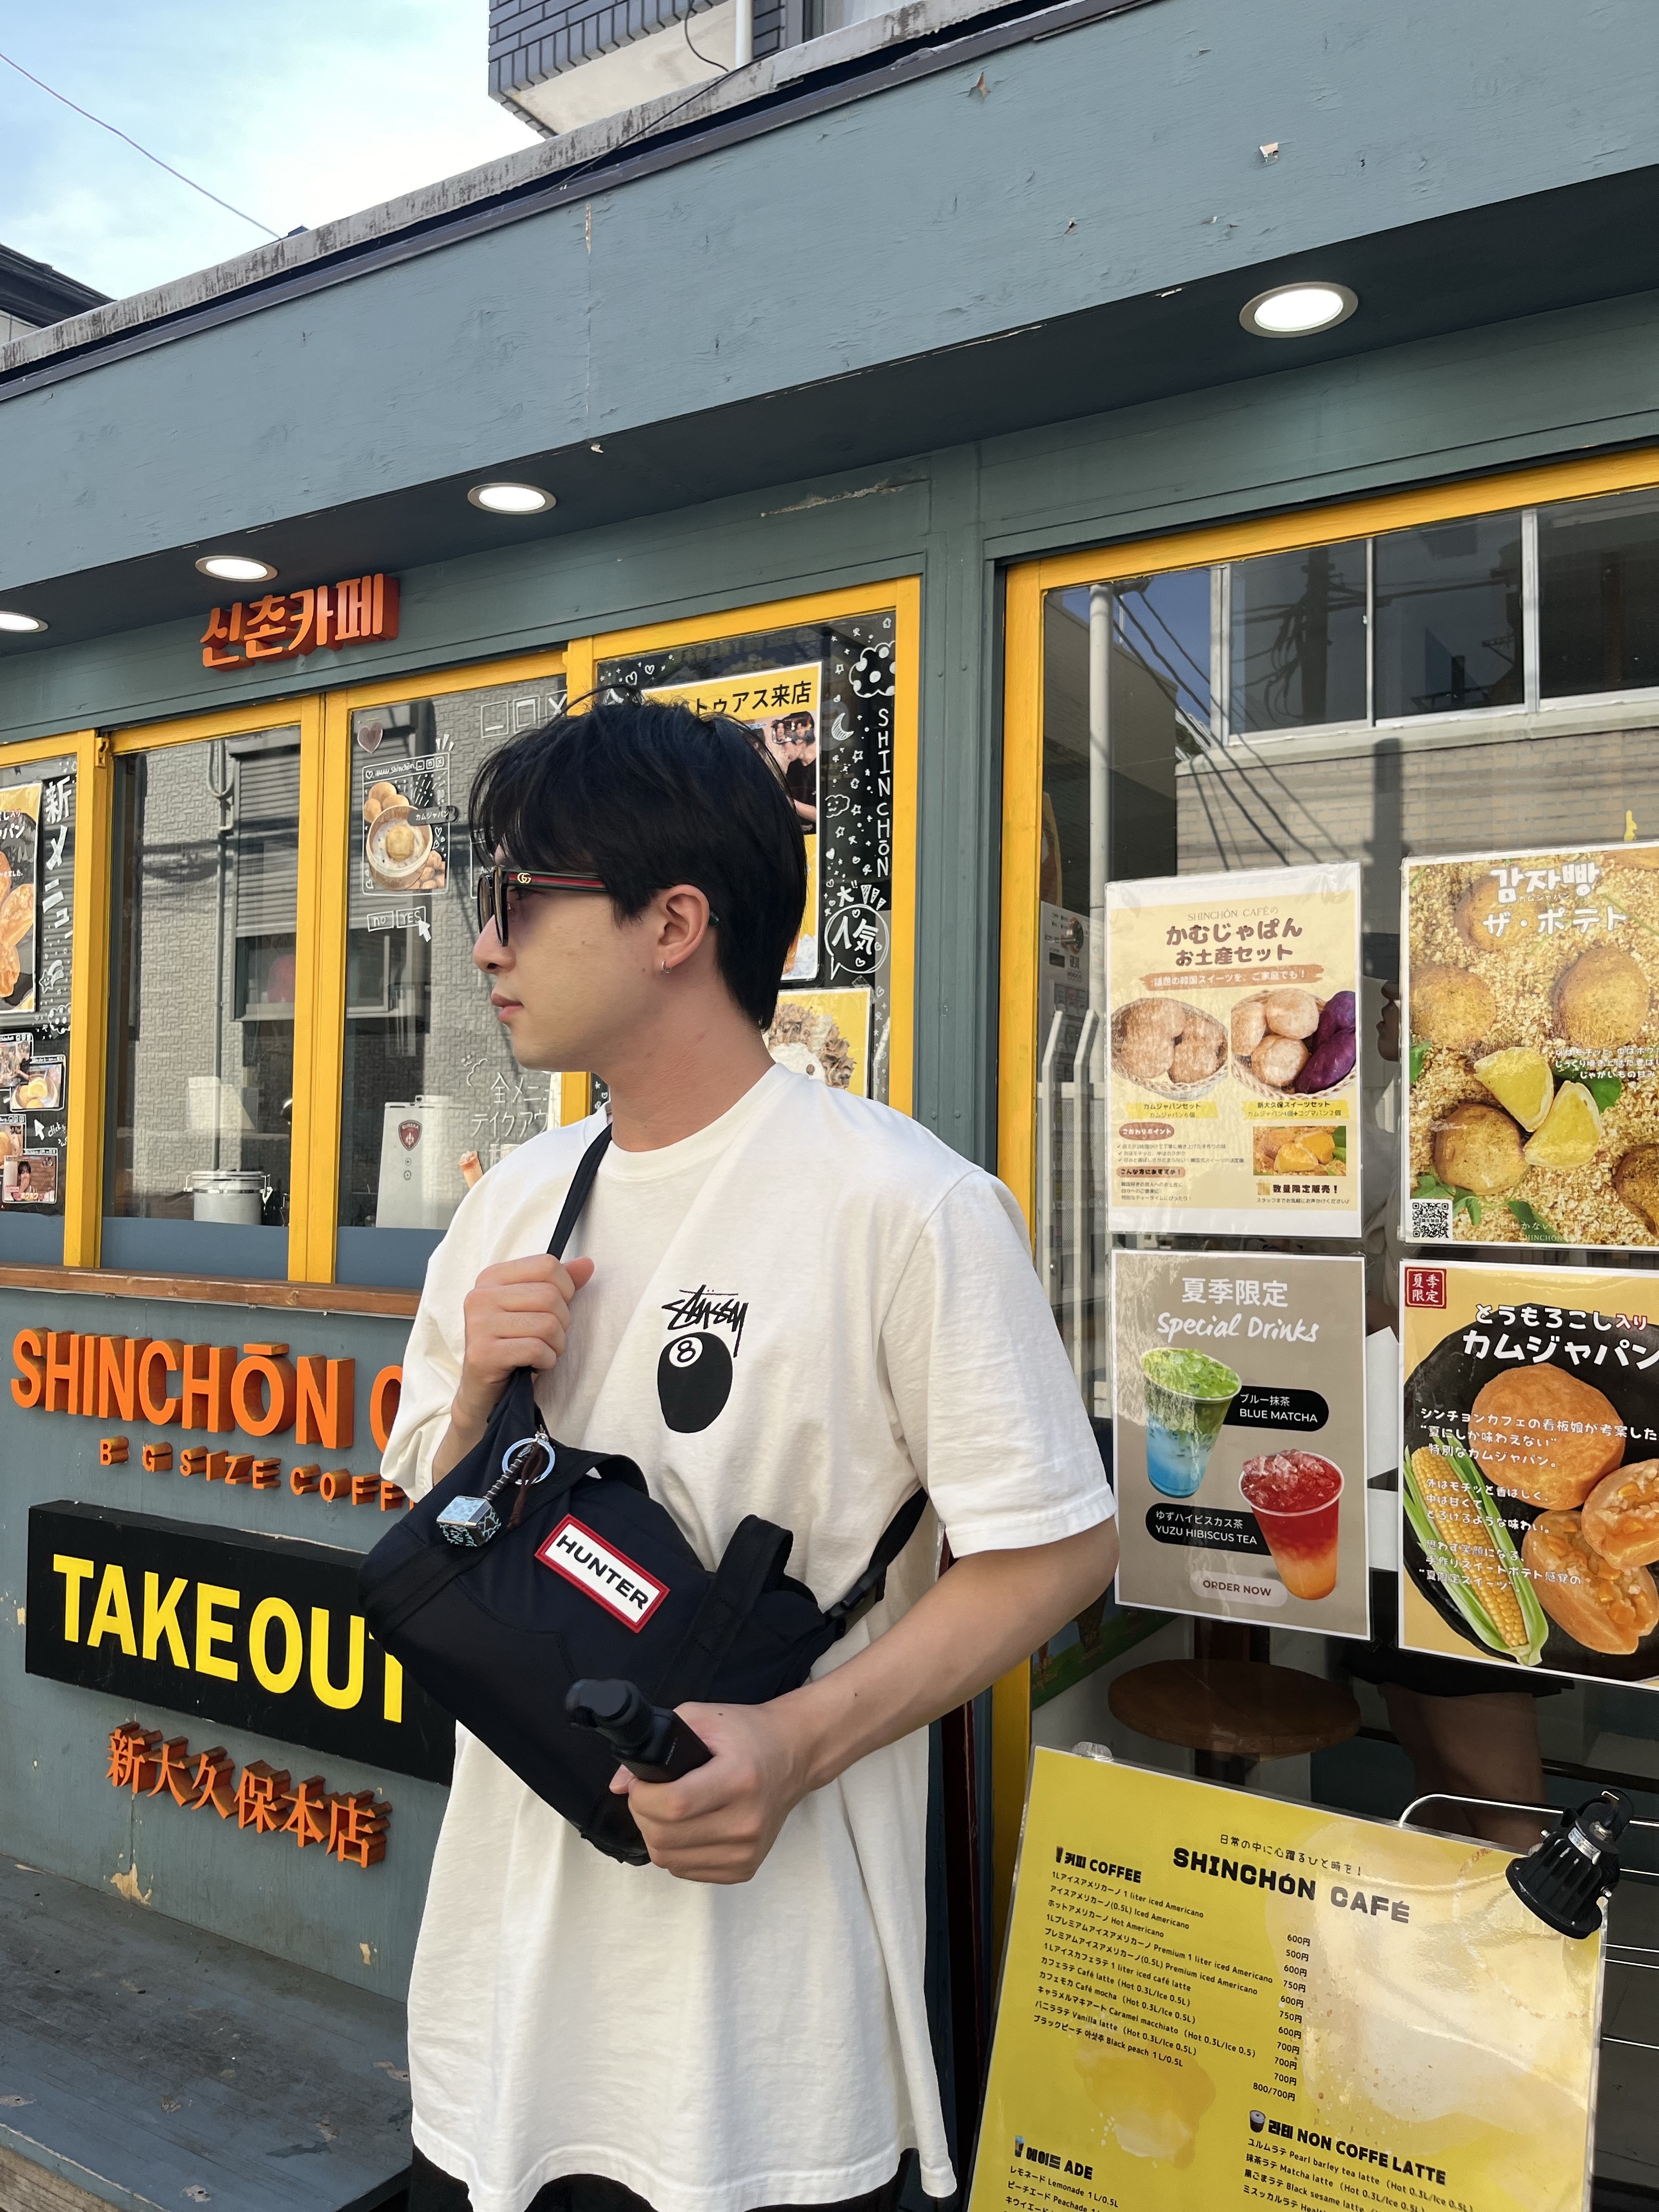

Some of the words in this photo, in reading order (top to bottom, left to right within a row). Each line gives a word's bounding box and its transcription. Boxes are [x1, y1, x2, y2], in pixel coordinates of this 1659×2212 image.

[200, 573, 385, 668] 신촌카페
[1490, 862, 1601, 904] 감자빵
[400, 910, 422, 924] YES
[831, 915, 879, 955] 人気
[1166, 917, 1304, 946] かむじゃぱん
[1482, 905, 1627, 938] ザ・ポテト
[1175, 944, 1294, 967] お土産セット
[1272, 1184, 1339, 1194] 数量限定販売！
[1181, 1277, 1289, 1308] 夏季限定
[1156, 1312, 1243, 1344] Special
[1247, 1316, 1320, 1343] Drinks
[1475, 1304, 1648, 1331] とうもろこし入り
[676, 1339, 696, 1363] 8
[1462, 1329, 1659, 1371] カムジャパン
[10, 1327, 355, 1449] SHINCHŌN
[1240, 1393, 1290, 1407] ブルー抹茶
[1239, 1408, 1268, 1420] BLUE
[1271, 1410, 1318, 1423] MATCHA
[1420, 1408, 1657, 1441] シンチョンカフェの看板娘が考案した
[180, 1445, 281, 1490] SIZE
[290, 1462, 415, 1513] COFF
[1155, 1510, 1244, 1530] ゆずハイビスカス茶
[1426, 1494, 1483, 1509] 中は甘くて
[1155, 1524, 1183, 1536] YUZU
[1186, 1528, 1234, 1543] HIBISCUS
[1237, 1534, 1257, 1546] TEA
[555, 1534, 650, 1611] HUNTER
[1203, 1579, 1240, 1593] ORDER
[1243, 1584, 1272, 1597] NOW
[53, 1553, 403, 1724] TAKEOUT
[106, 1725, 385, 1869] 新大久保本店
[1064, 1852, 1087, 1869] 커피
[1089, 1859, 1142, 1884] COFFEE
[1173, 1847, 1316, 1901] SHINCHÓN
[1330, 1886, 1410, 1924] CAFÉ
[1048, 1899, 1109, 1921] ホットアメリカーノ
[1110, 1916, 1124, 1927] Hot
[1126, 1921, 1164, 1938] Americano
[1284, 1964, 1307, 1978] 600円
[1130, 1892, 1147, 1902] liter
[1148, 1897, 1164, 1908] iced
[1165, 1901, 1204, 1918] Americano
[1287, 1934, 1311, 1947] 600円
[1134, 1908, 1149, 1918] Iced
[1150, 1913, 1189, 1929] Americano
[1286, 1949, 1309, 1962] 500円
[1044, 1942, 1109, 1967] 1Lアイスカフェラテ
[1117, 1963, 1134, 1974] liter
[1136, 1969, 1152, 1980] iced
[1153, 1976, 1170, 1985] café
[1172, 1979, 1191, 1991] latte
[1279, 2010, 1302, 2024] 750円
[1153, 1944, 1186, 1959] Premium
[1194, 1955, 1212, 1966] liter
[1214, 1960, 1230, 1972] iced
[1232, 1966, 1273, 1984] Americano
[1283, 1979, 1306, 1993] 750円
[1165, 1962, 1197, 1978] Premium
[1199, 1972, 1216, 1983] iced
[1217, 1977, 1258, 1995] Americano
[1280, 1995, 1304, 2008] 600円
[1039, 1971, 1074, 1987] カフェモカ
[1075, 1982, 1092, 1993] Café
[1094, 1989, 1117, 2000] mocha
[1277, 2041, 1300, 2058] 700円
[1041, 1956, 1075, 1972] カフェラテ
[1077, 1967, 1094, 1978] Café
[1096, 1972, 1115, 1984] latte
[1278, 2026, 1302, 2040] 600円
[1037, 1985, 1107, 2012] キャラメルマキアート
[1109, 2007, 1139, 2022] Caramel
[1140, 2018, 1178, 2034] macchiato
[1274, 2056, 1297, 2070] 700円
[1034, 2015, 1082, 2035] ブラックピーチ
[1106, 2036, 1126, 2050] Black
[1127, 2045, 1149, 2056] peach
[1252, 2082, 1296, 2102] 800/700円
[1072, 2011, 1097, 2025] Vanilla
[1099, 2019, 1118, 2031] latte
[1274, 2072, 1297, 2086] 700円
[1063, 2159, 1093, 2181] ADE
[1246, 2153, 1277, 2169] 抹茶ラテ
[1279, 2163, 1310, 2180] Matcha
[1312, 2174, 1333, 2187] latte
[1248, 2138, 1287, 2155] ユルムラテ
[1289, 2150, 1311, 2164] Pearl
[1313, 2157, 1339, 2174] barley
[1342, 2166, 1356, 2177] tea
[1358, 2171, 1380, 2185] latte
[1296, 2128, 1332, 2151] NON
[1335, 2140, 1389, 2168] COFFE
[1392, 2156, 1446, 2186] LATTE
[1008, 2180, 1051, 2200] ピーチエード
[1053, 2195, 1087, 2212] Peachade
[1010, 2165, 1046, 2183] レモネード
[1048, 2178, 1085, 2197] Lemonade
[1286, 2182, 1307, 2196] Black
[1310, 2191, 1340, 2206] sesame
[1342, 2199, 1364, 2212] latte
